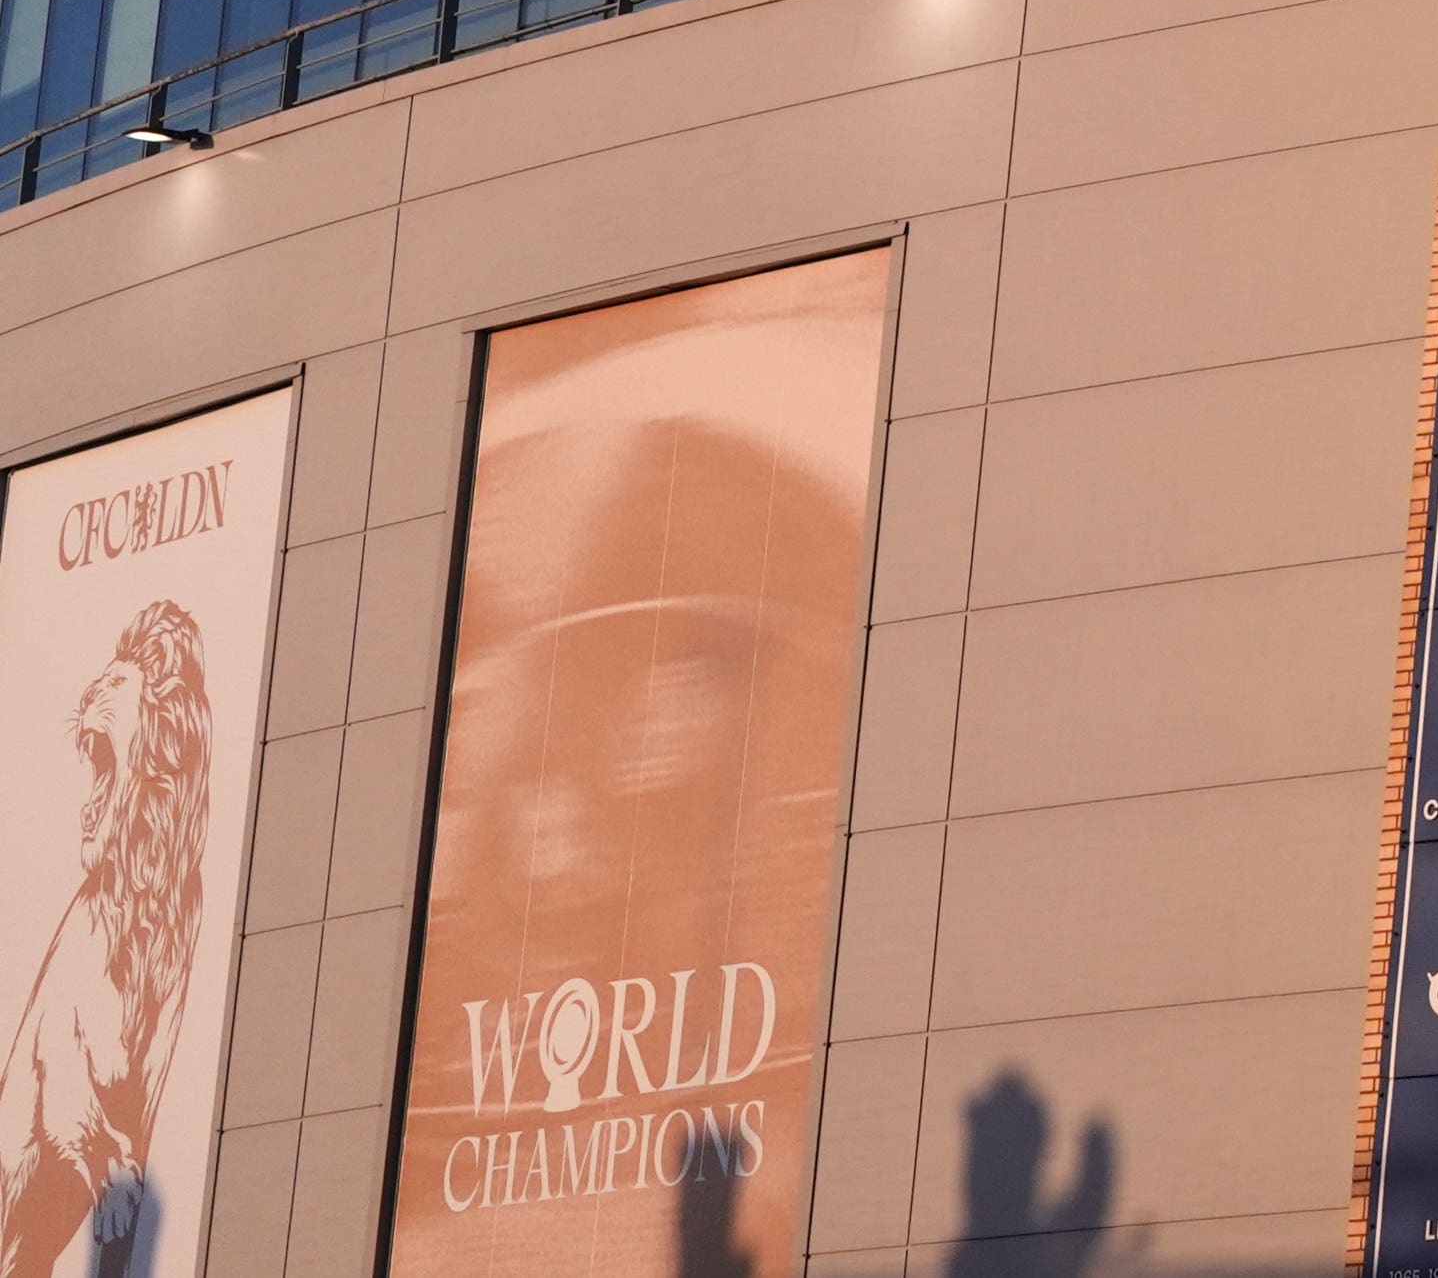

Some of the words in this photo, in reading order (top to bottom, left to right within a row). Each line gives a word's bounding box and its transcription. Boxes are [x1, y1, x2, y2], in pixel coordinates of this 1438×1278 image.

[58, 491, 134, 572] CFC
[152, 459, 233, 540] LDN
[443, 1100, 765, 1213] CHAMPIONS
